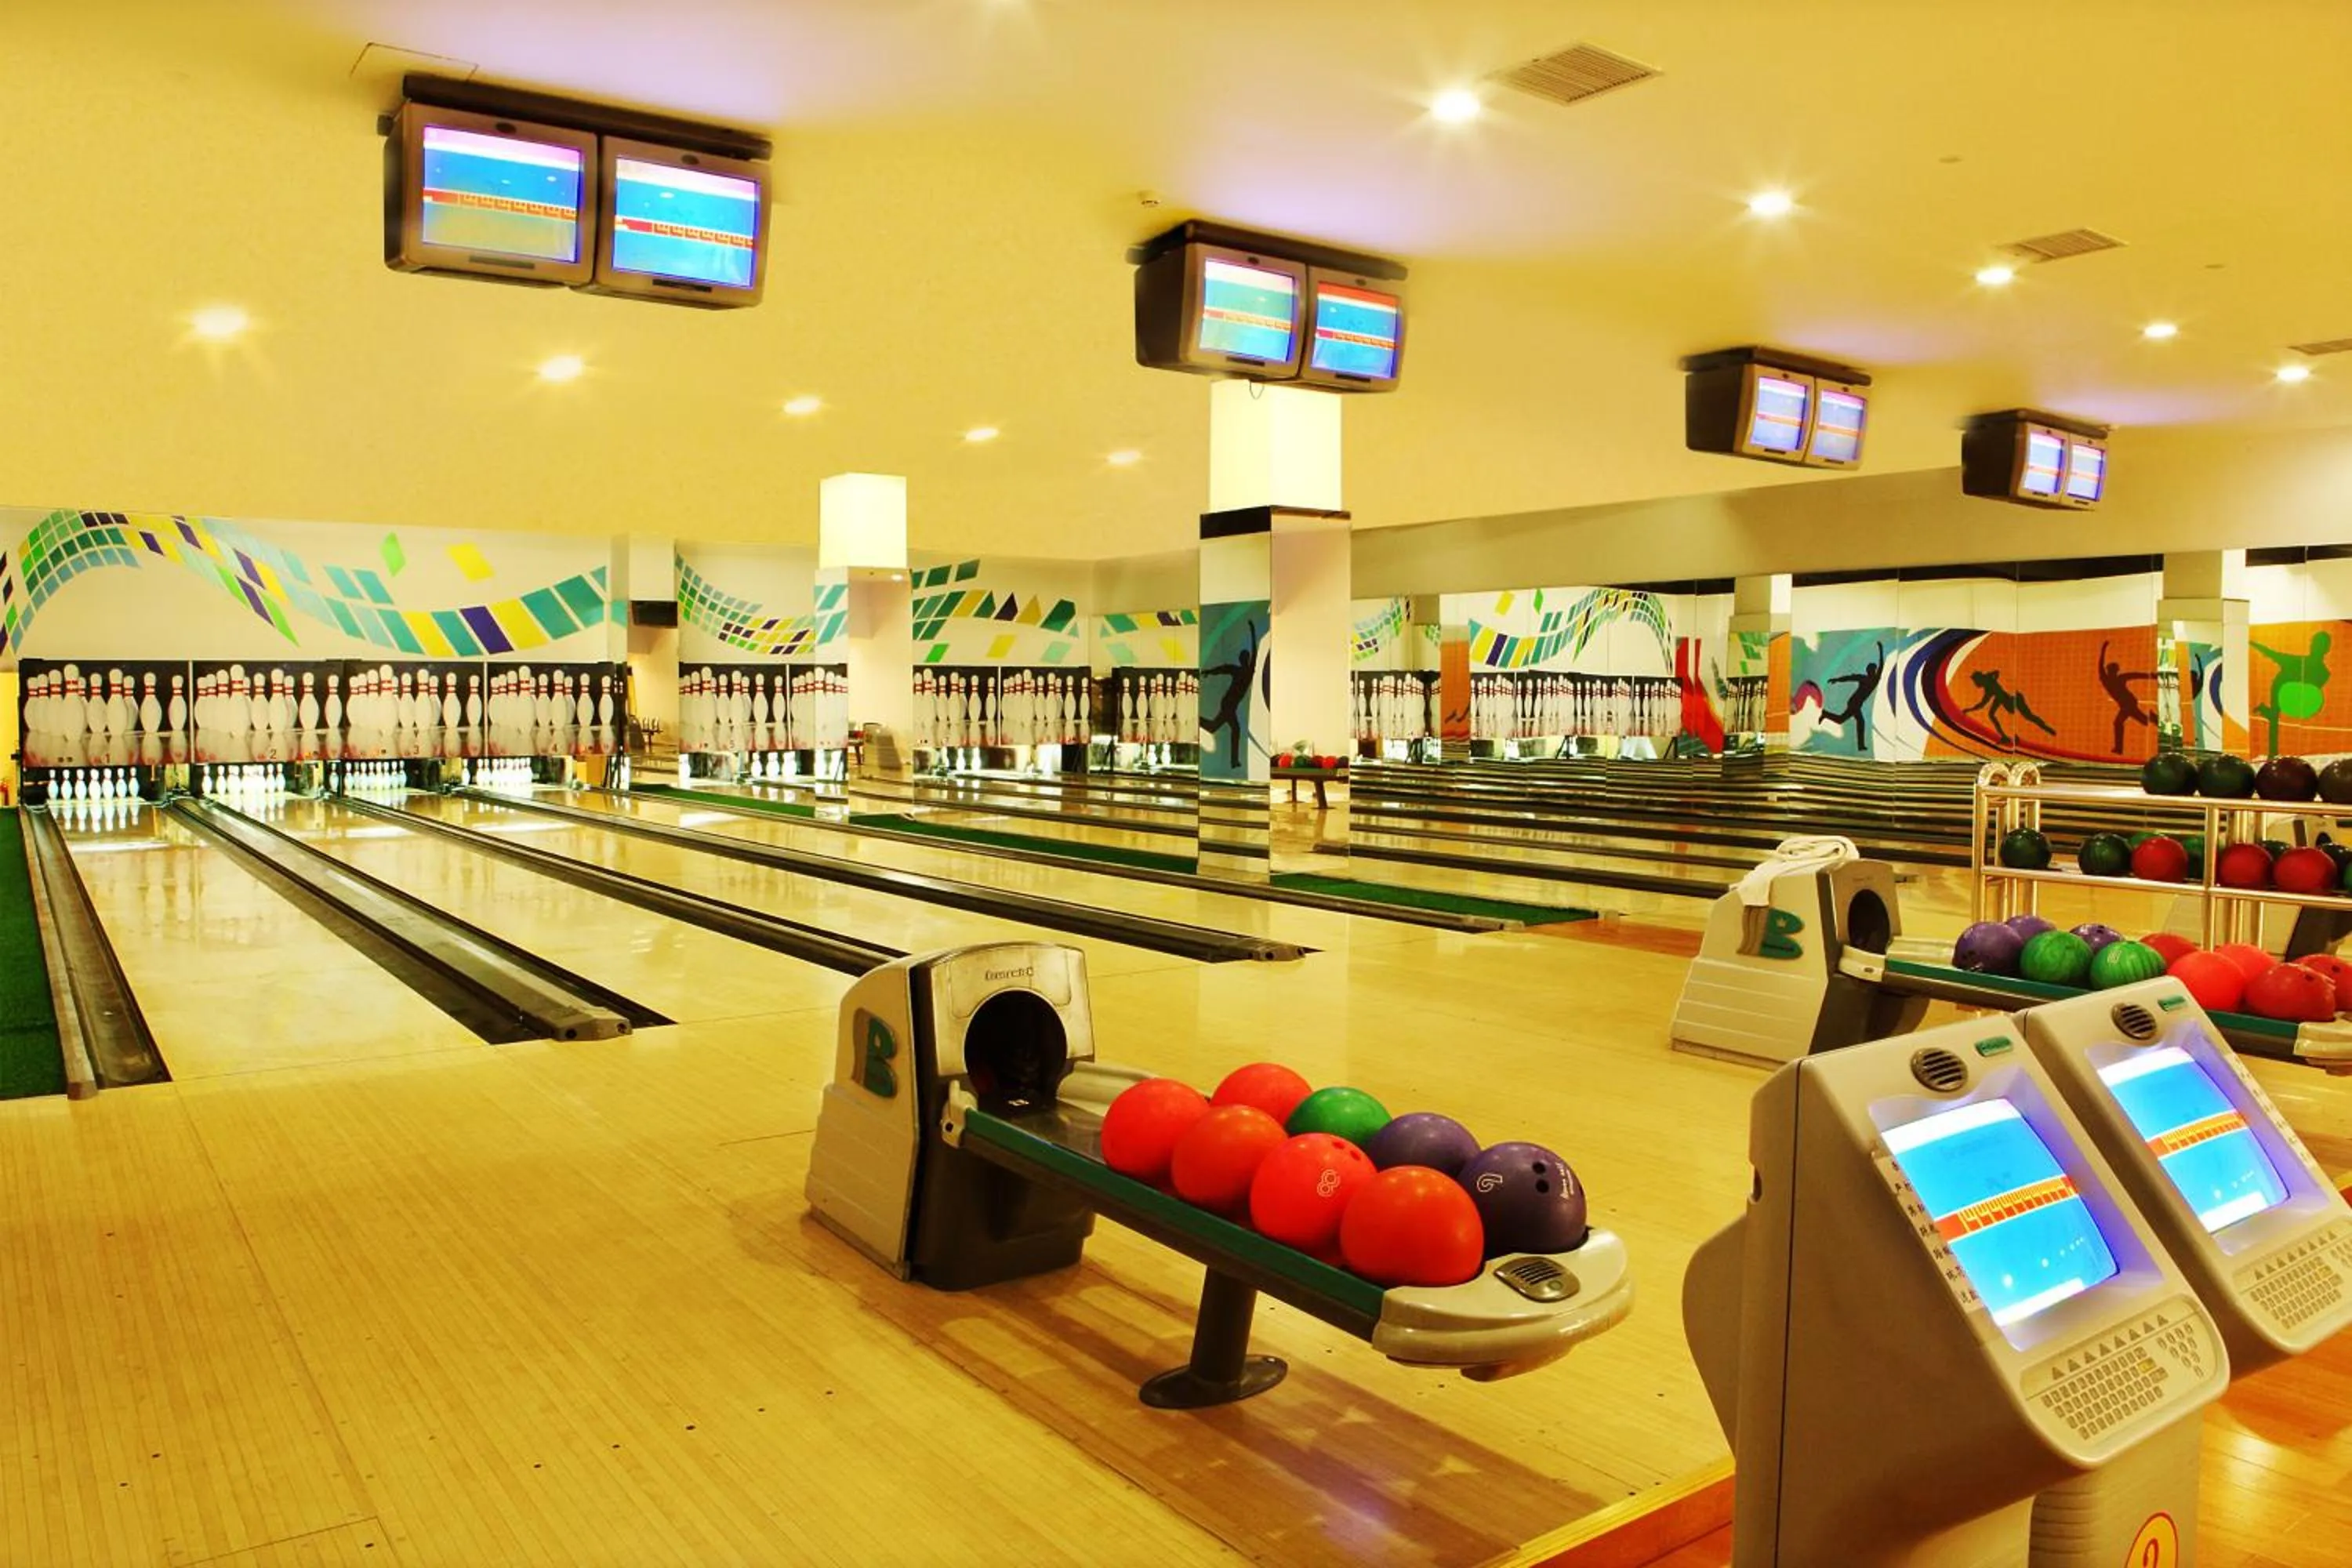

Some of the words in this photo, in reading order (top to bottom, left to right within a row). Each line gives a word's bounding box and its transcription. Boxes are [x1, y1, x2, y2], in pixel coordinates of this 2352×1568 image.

[270, 749, 277, 760] 2
[1759, 906, 1806, 960] B
[862, 1016, 898, 1099] B
[1316, 1168, 1341, 1197] 8
